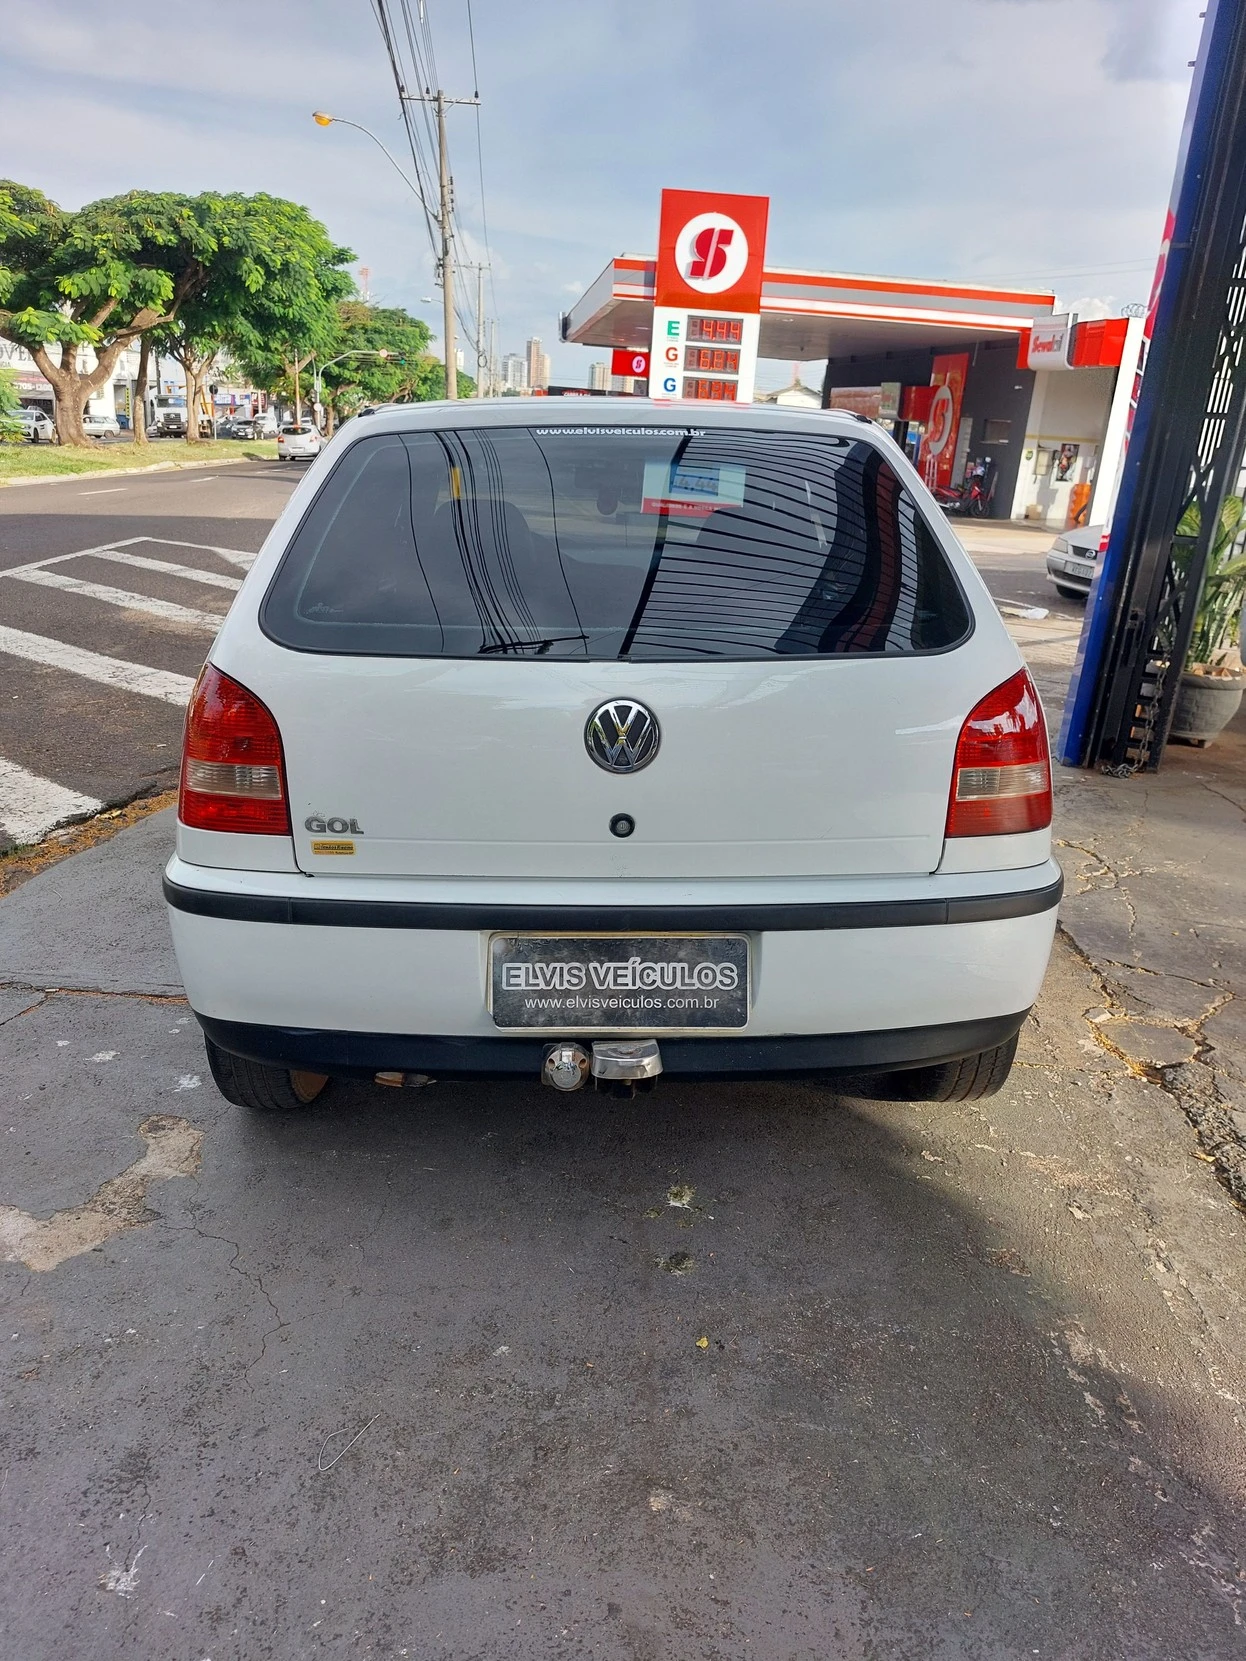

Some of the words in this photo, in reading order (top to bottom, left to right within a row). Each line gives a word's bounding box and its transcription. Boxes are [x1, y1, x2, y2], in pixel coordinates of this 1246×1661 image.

[667, 320, 681, 336] E
[665, 346, 679, 362] G
[663, 377, 677, 392] G
[535, 426, 706, 438] www.elvisveiculos.com.br
[304, 816, 365, 835] GOL
[502, 961, 586, 990] ELVIS
[589, 956, 739, 990] VEÍCULOS
[524, 994, 719, 1010] www.elvisveiculos.com.br
